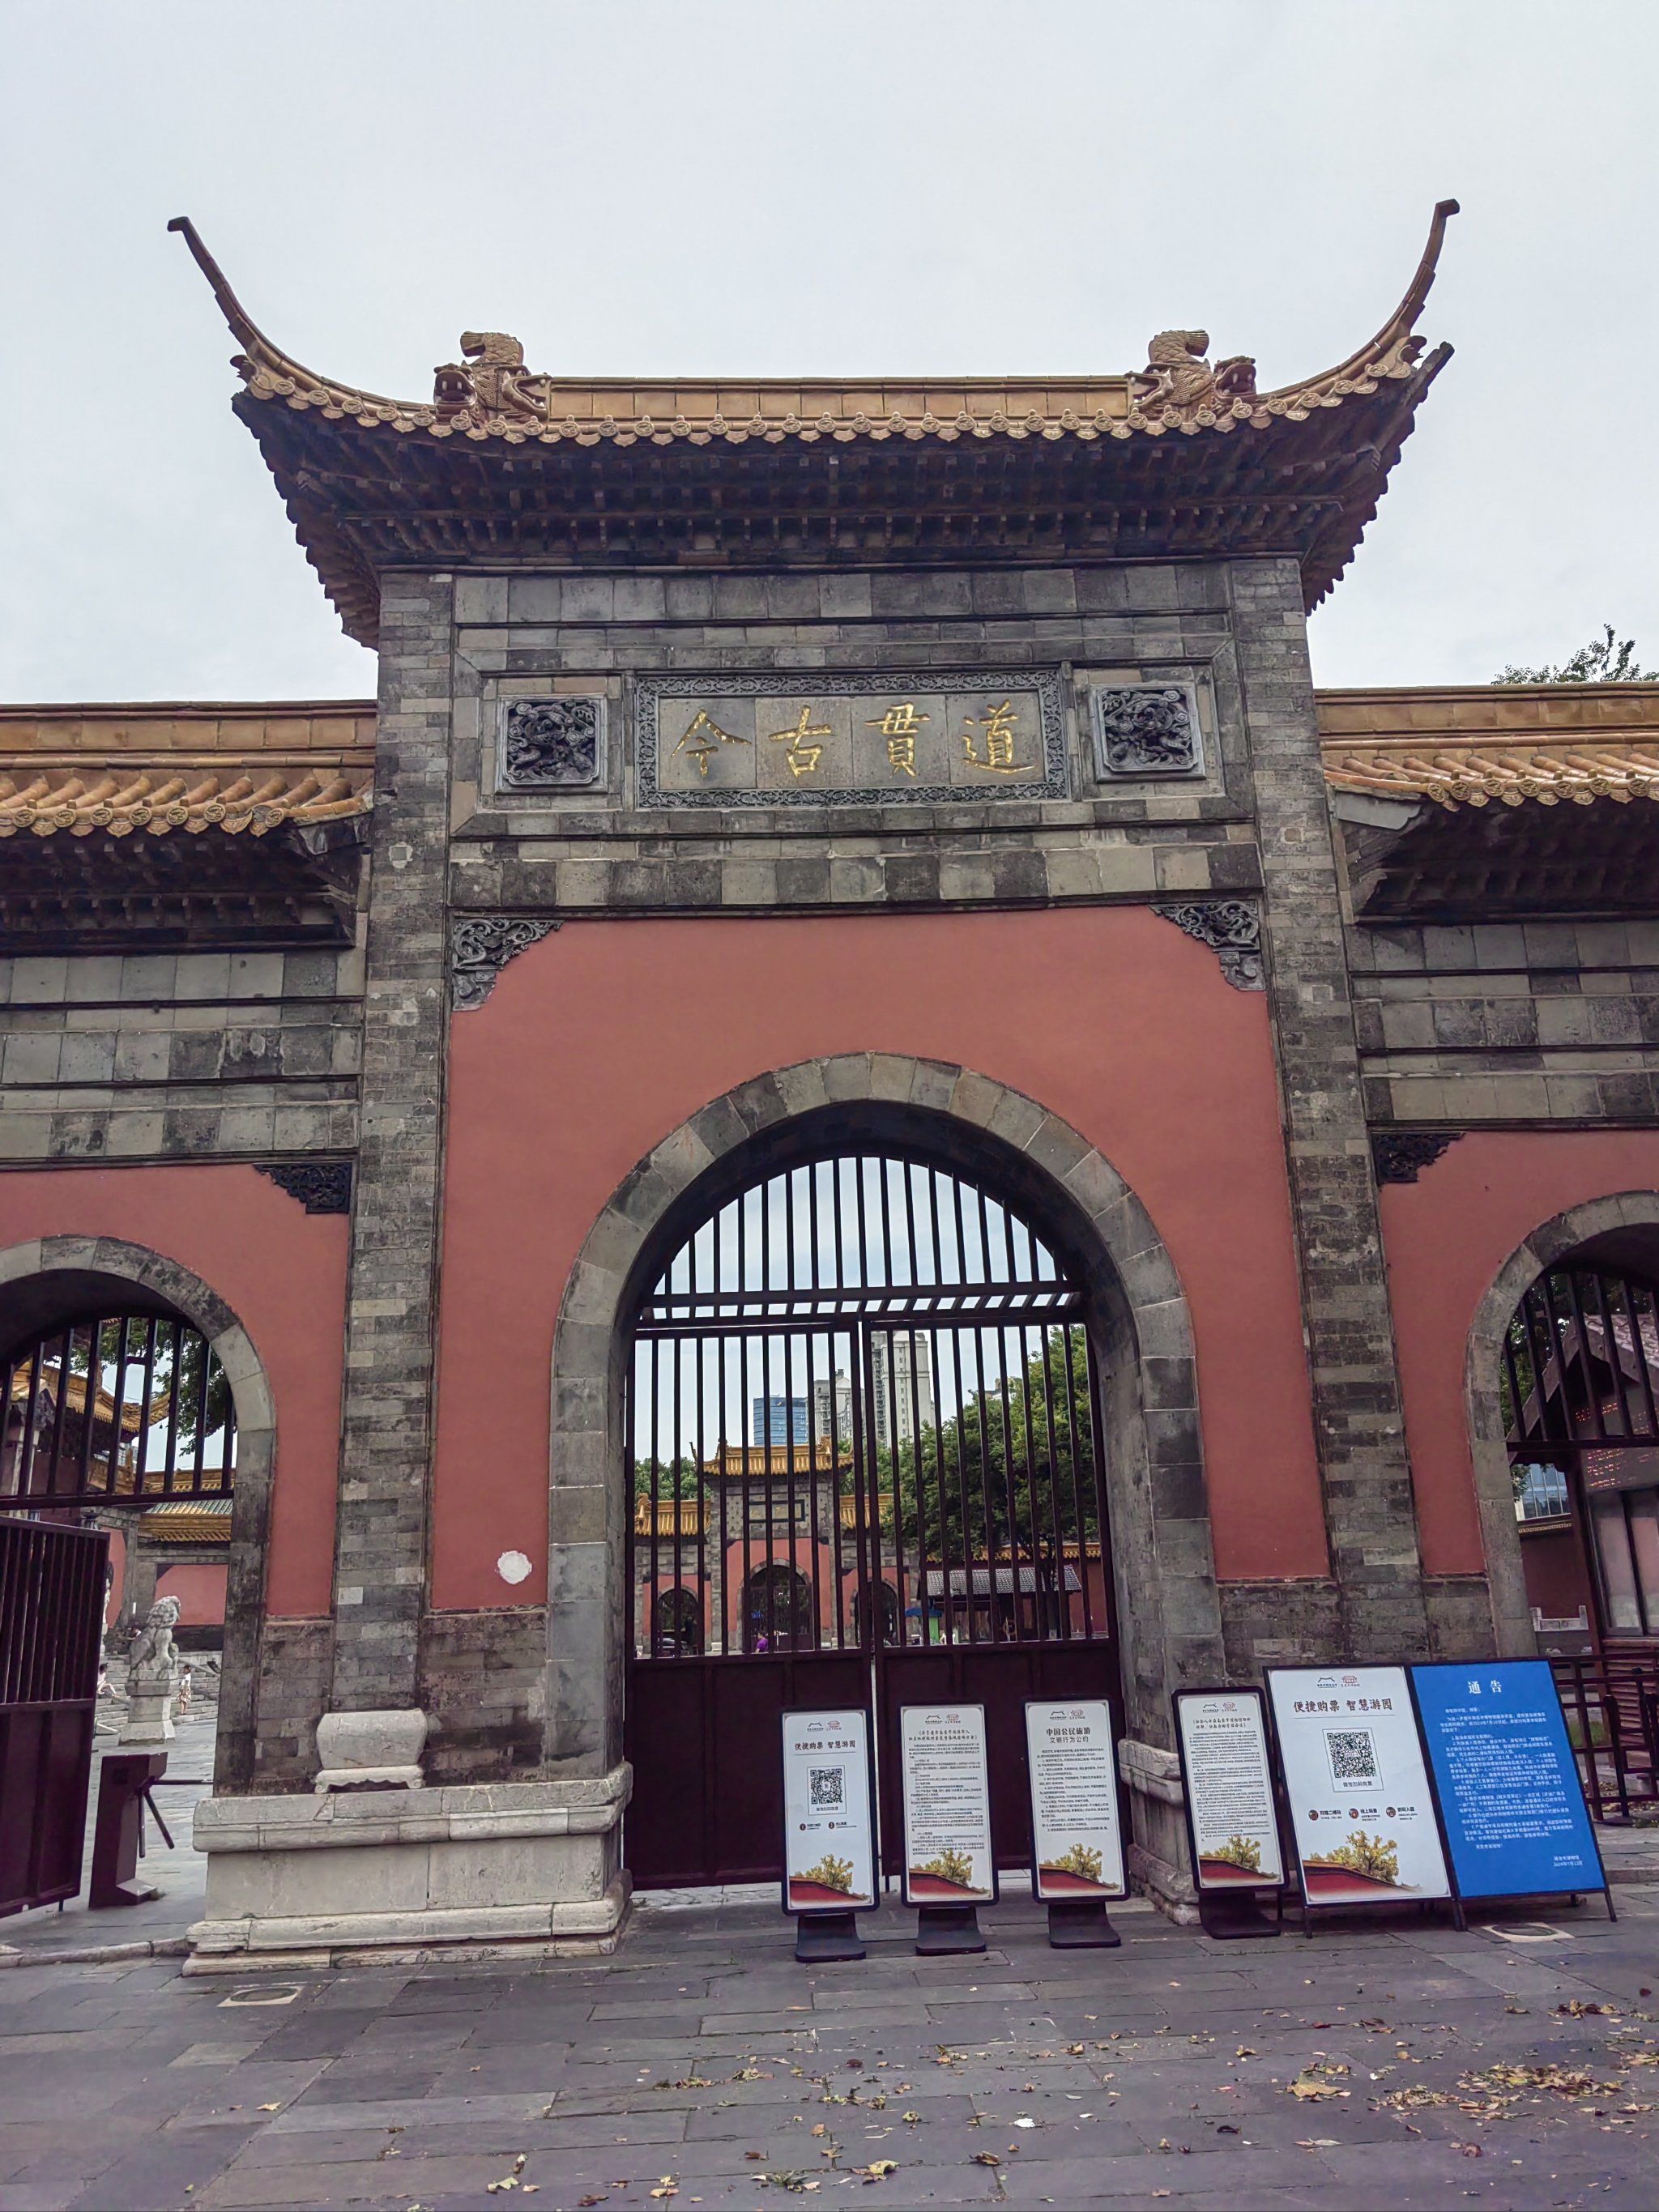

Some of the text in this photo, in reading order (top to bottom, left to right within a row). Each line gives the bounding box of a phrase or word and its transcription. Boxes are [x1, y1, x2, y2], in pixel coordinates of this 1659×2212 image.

[1293, 1698, 1392, 1713] 便捷购票 智慧游园
[1046, 1727, 1090, 1737] 中国公民旅游
[827, 1740, 855, 1749] 智慧游园
[1050, 1736, 1089, 1744] 文明行为公约
